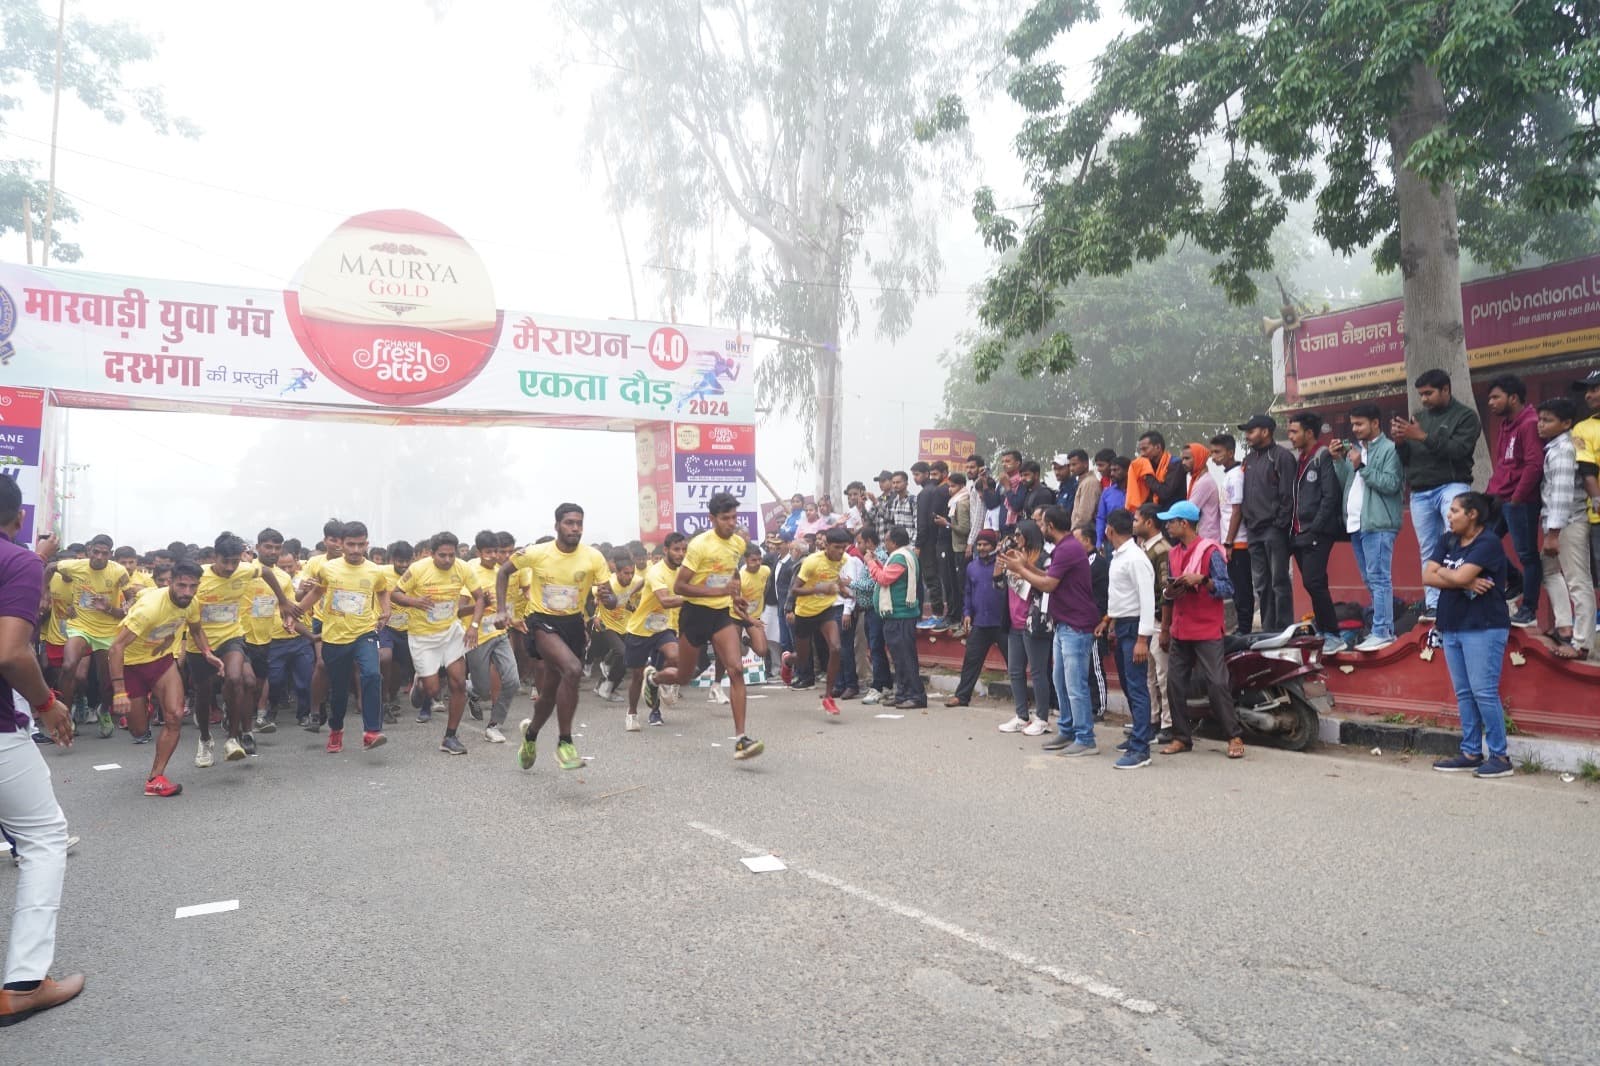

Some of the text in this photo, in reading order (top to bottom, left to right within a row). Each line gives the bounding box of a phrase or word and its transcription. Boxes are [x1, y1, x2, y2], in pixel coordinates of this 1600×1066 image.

[340, 252, 458, 284] MAURYA
[369, 279, 429, 297] GOLD
[1471, 291, 1521, 326] punjab
[1523, 276, 1590, 308] national
[23, 288, 149, 338] मारवाड़ी
[159, 299, 218, 343] युवा
[227, 299, 274, 338] मंच
[1532, 312, 1552, 325] name
[1553, 309, 1567, 322] you
[1300, 332, 1339, 352] पंजाब
[359, 339, 444, 369] fresh
[103, 346, 204, 386] दरभंगा
[206, 365, 227, 382] की
[377, 361, 427, 381] atta
[518, 369, 676, 411] एकता दौड़
[690, 399, 729, 416] 2024
[704, 459, 747, 467] CARATLANE
[701, 515, 749, 527] UTSH
